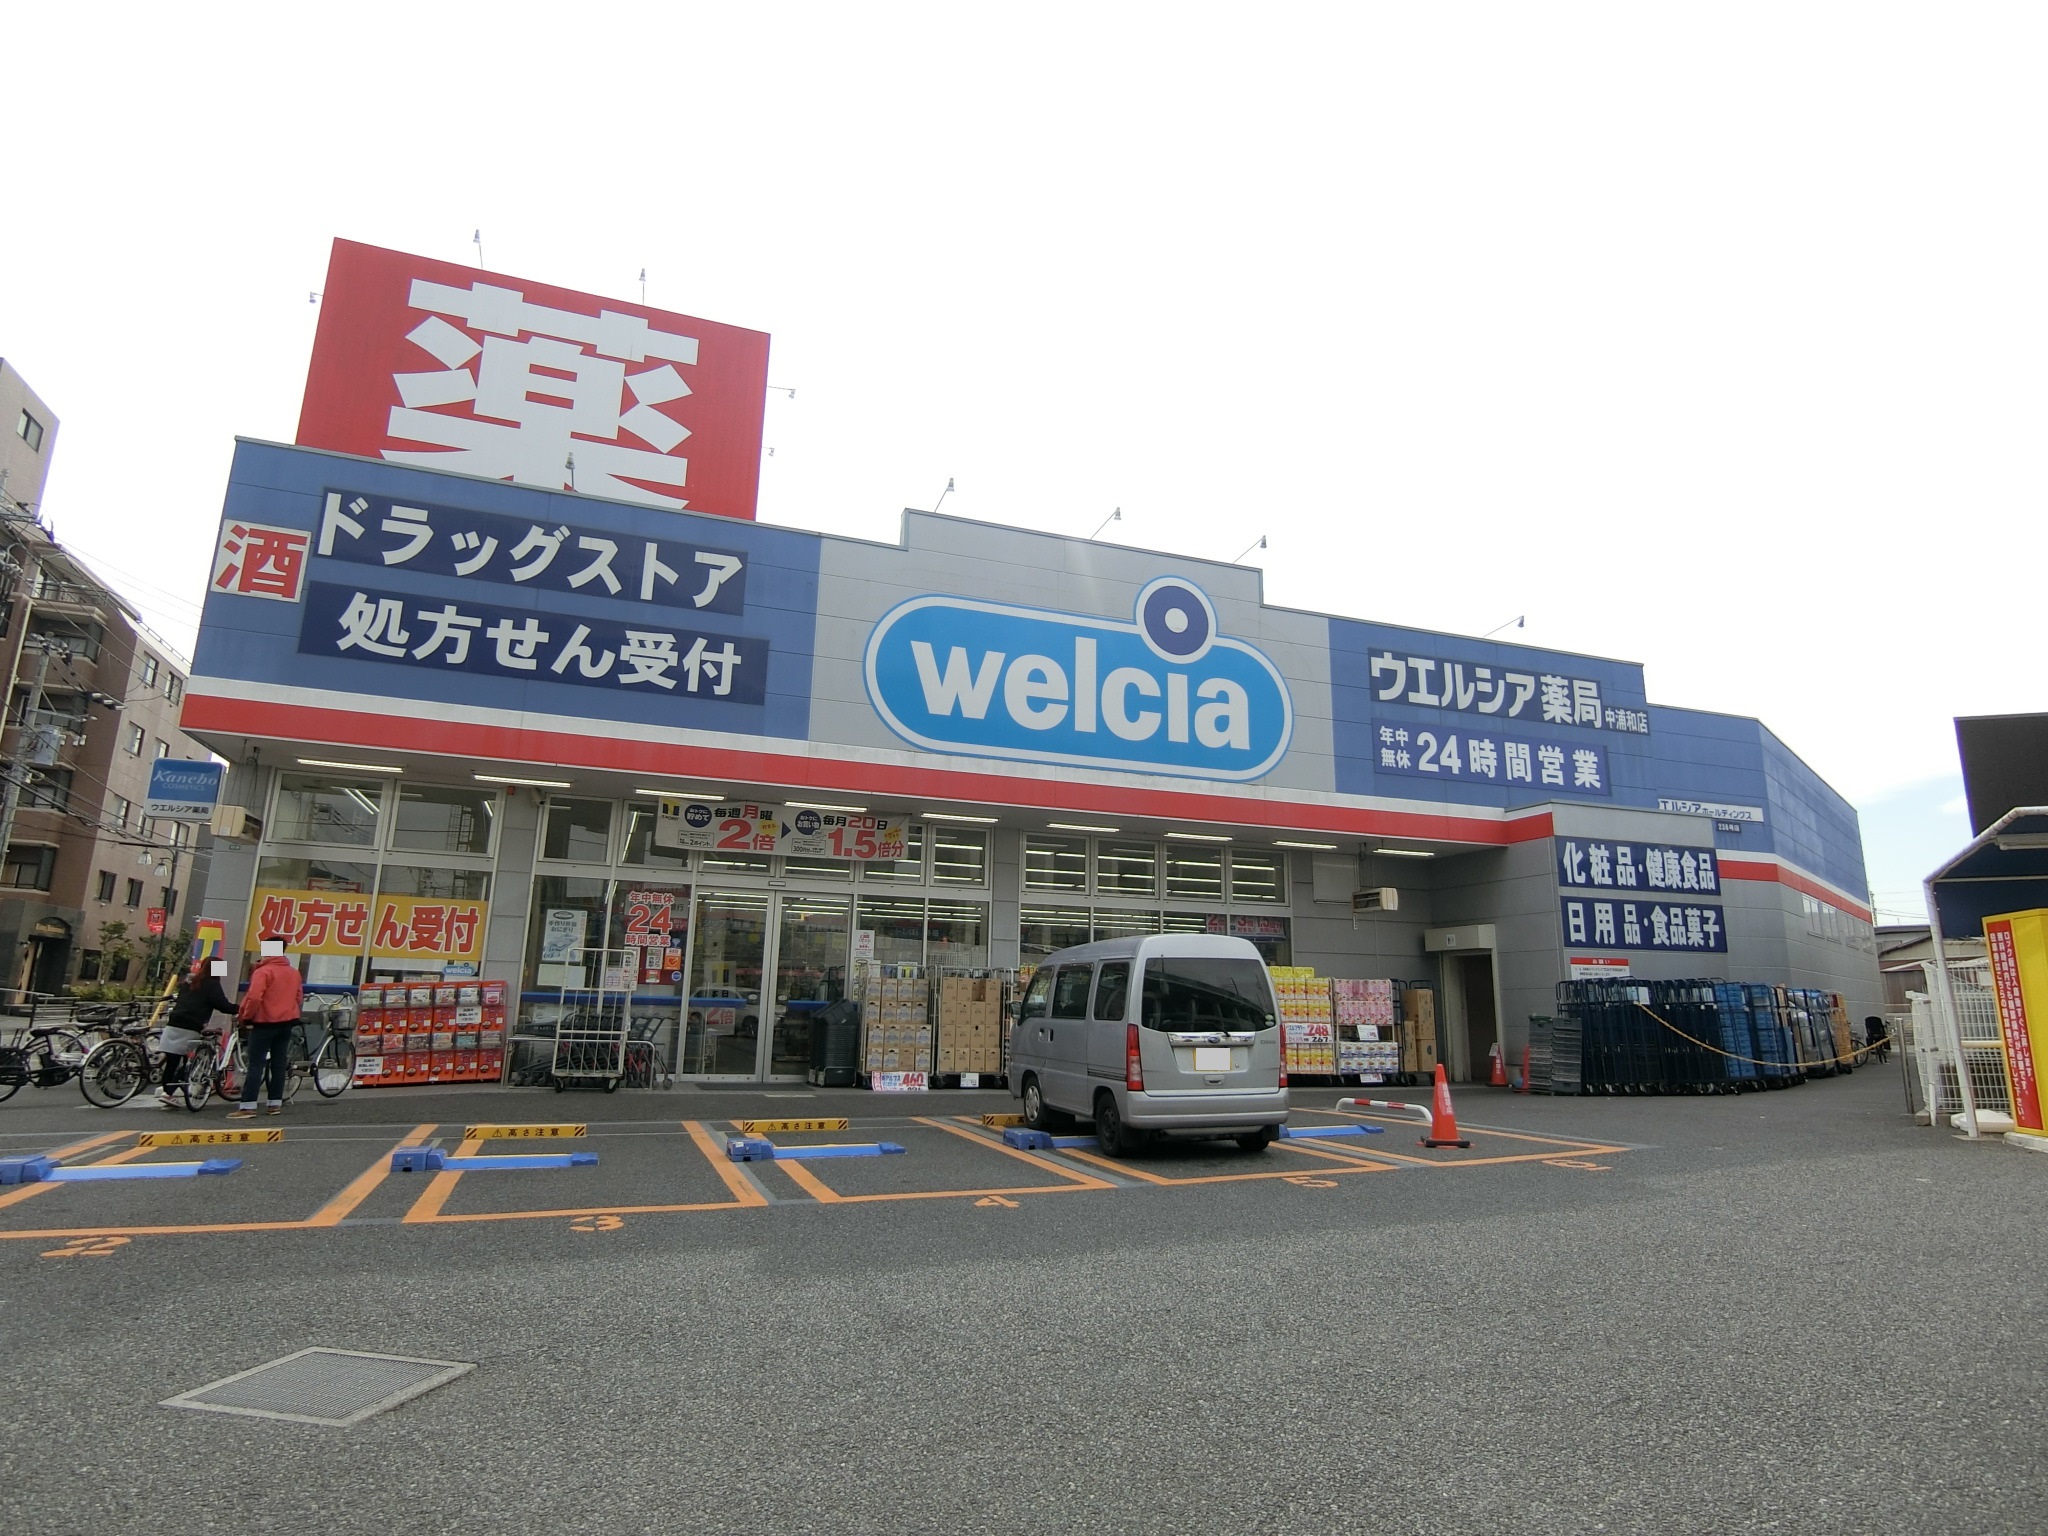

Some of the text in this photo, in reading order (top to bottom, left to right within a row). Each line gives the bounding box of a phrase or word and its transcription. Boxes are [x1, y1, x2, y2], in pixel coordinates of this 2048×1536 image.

[381, 279, 699, 509] 薬
[215, 522, 307, 599] 酒
[316, 491, 744, 609] ドラッグストア
[336, 591, 742, 696] 処方せん受付
[910, 586, 1251, 751] welcia
[1370, 651, 1603, 729] ウエルシア薬局
[1604, 709, 1649, 734] 中浦和店
[1379, 725, 1409, 747] 年中
[1380, 746, 1411, 769] 無休
[1416, 732, 1602, 789] 24時間営業
[152, 770, 218, 786] Kanebo
[162, 782, 206, 791] COSMETICS
[151, 803, 210, 815] ウエルシア薬局
[686, 812, 711, 822] 貯めて
[713, 804, 774, 821] 毎週月曜
[1657, 800, 1753, 820] エルシアホールディングス
[822, 814, 888, 831] 毎月20日
[716, 818, 776, 851] 2倍
[827, 827, 905, 859] 1.5倍分
[1562, 841, 1716, 891] 化粧品・健康食品
[629, 890, 675, 905] 年中無休
[256, 895, 479, 954] 処方せん受付
[627, 904, 673, 934] 24
[1567, 902, 1720, 948] 日用品・食品菓子
[624, 934, 672, 947] 時間営業
[902, 1072, 925, 1087] 460
[507, 1127, 560, 1138] 高さ注意
[780, 1121, 826, 1131] 高さ注意
[189, 1132, 251, 1144] 高さ注意
[569, 1215, 625, 1232] 3
[40, 1235, 131, 1257] 2
